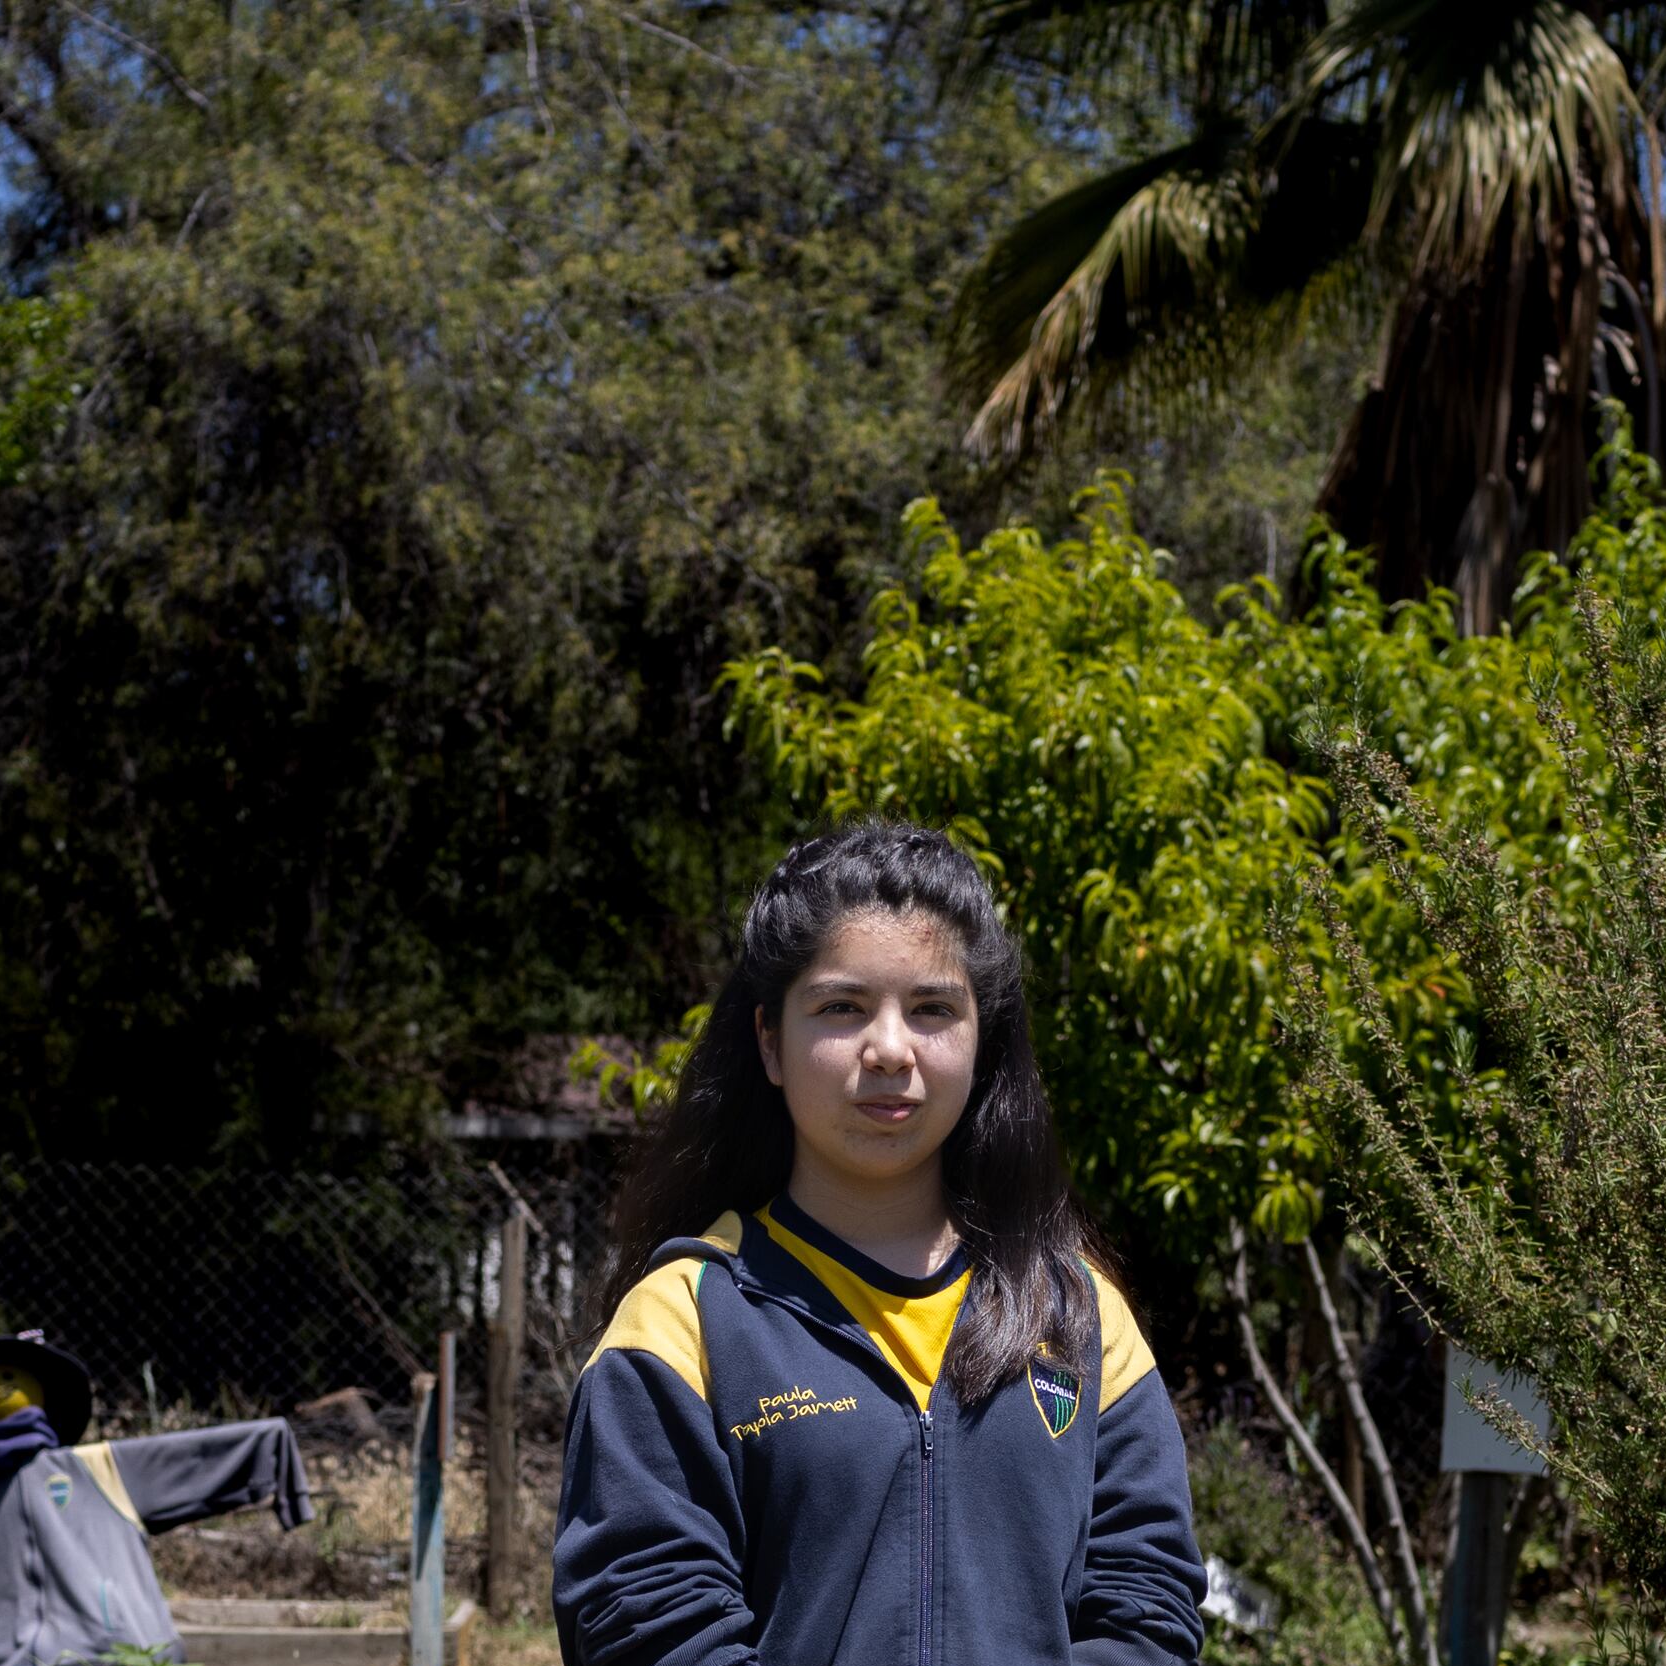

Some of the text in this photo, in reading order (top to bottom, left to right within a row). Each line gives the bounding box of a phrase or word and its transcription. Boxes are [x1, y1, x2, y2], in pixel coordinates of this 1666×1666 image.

[758, 1385, 817, 1412] Paula
[1034, 1378, 1076, 1400] COLONIAL
[787, 1396, 858, 1420] Jamett
